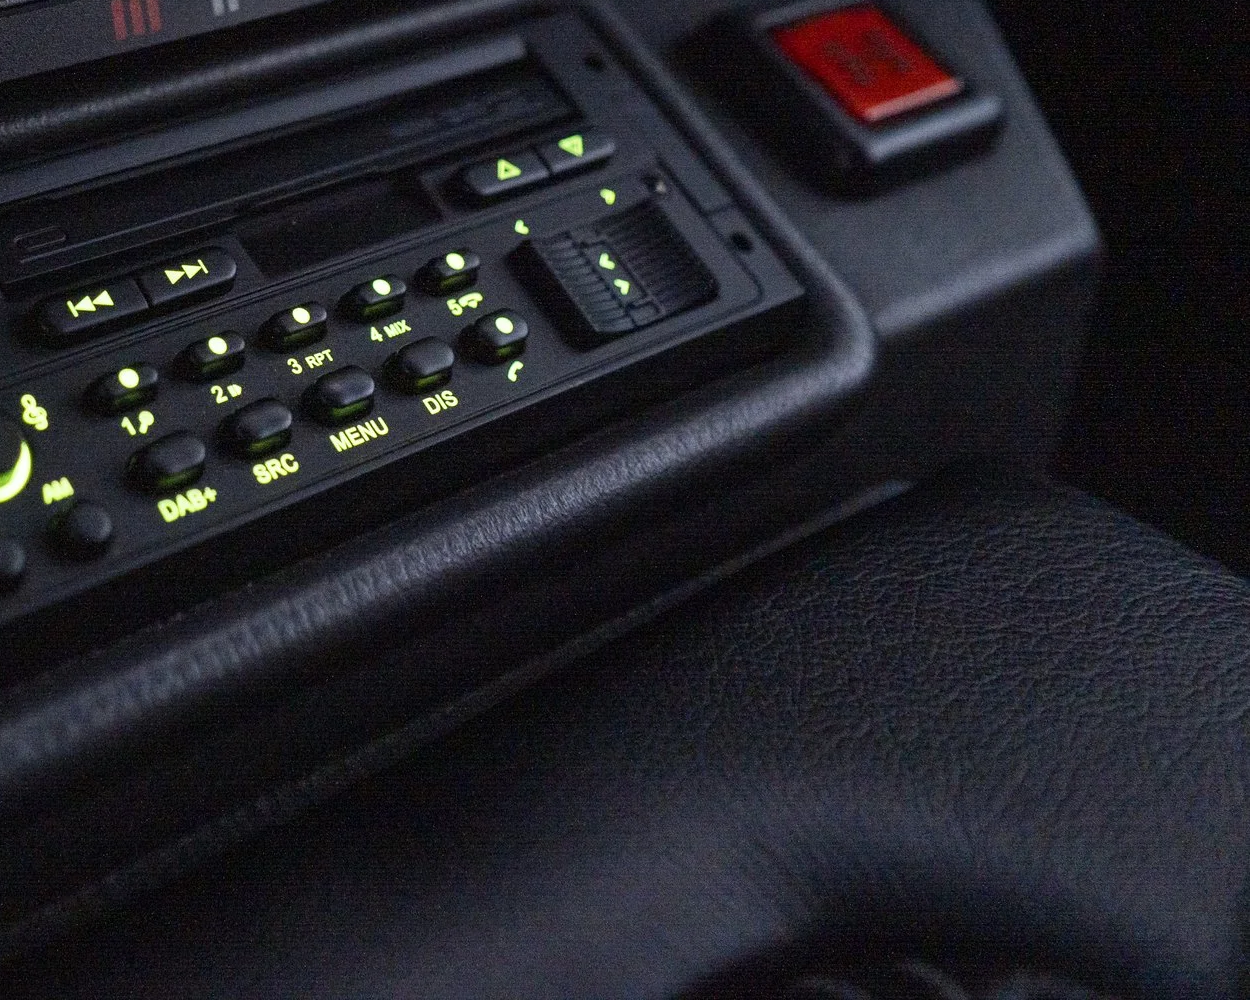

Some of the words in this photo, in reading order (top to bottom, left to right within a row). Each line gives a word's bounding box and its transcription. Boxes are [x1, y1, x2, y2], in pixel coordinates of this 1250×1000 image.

[369, 325, 384, 343] 4
[386, 319, 412, 339] MIX
[287, 357, 303, 375] 3
[305, 348, 334, 370] RPT
[210, 384, 228, 405] 2
[421, 389, 459, 415] DIS
[329, 416, 390, 453] MENU
[252, 452, 300, 485] SRC
[156, 486, 218, 523] DAB+
